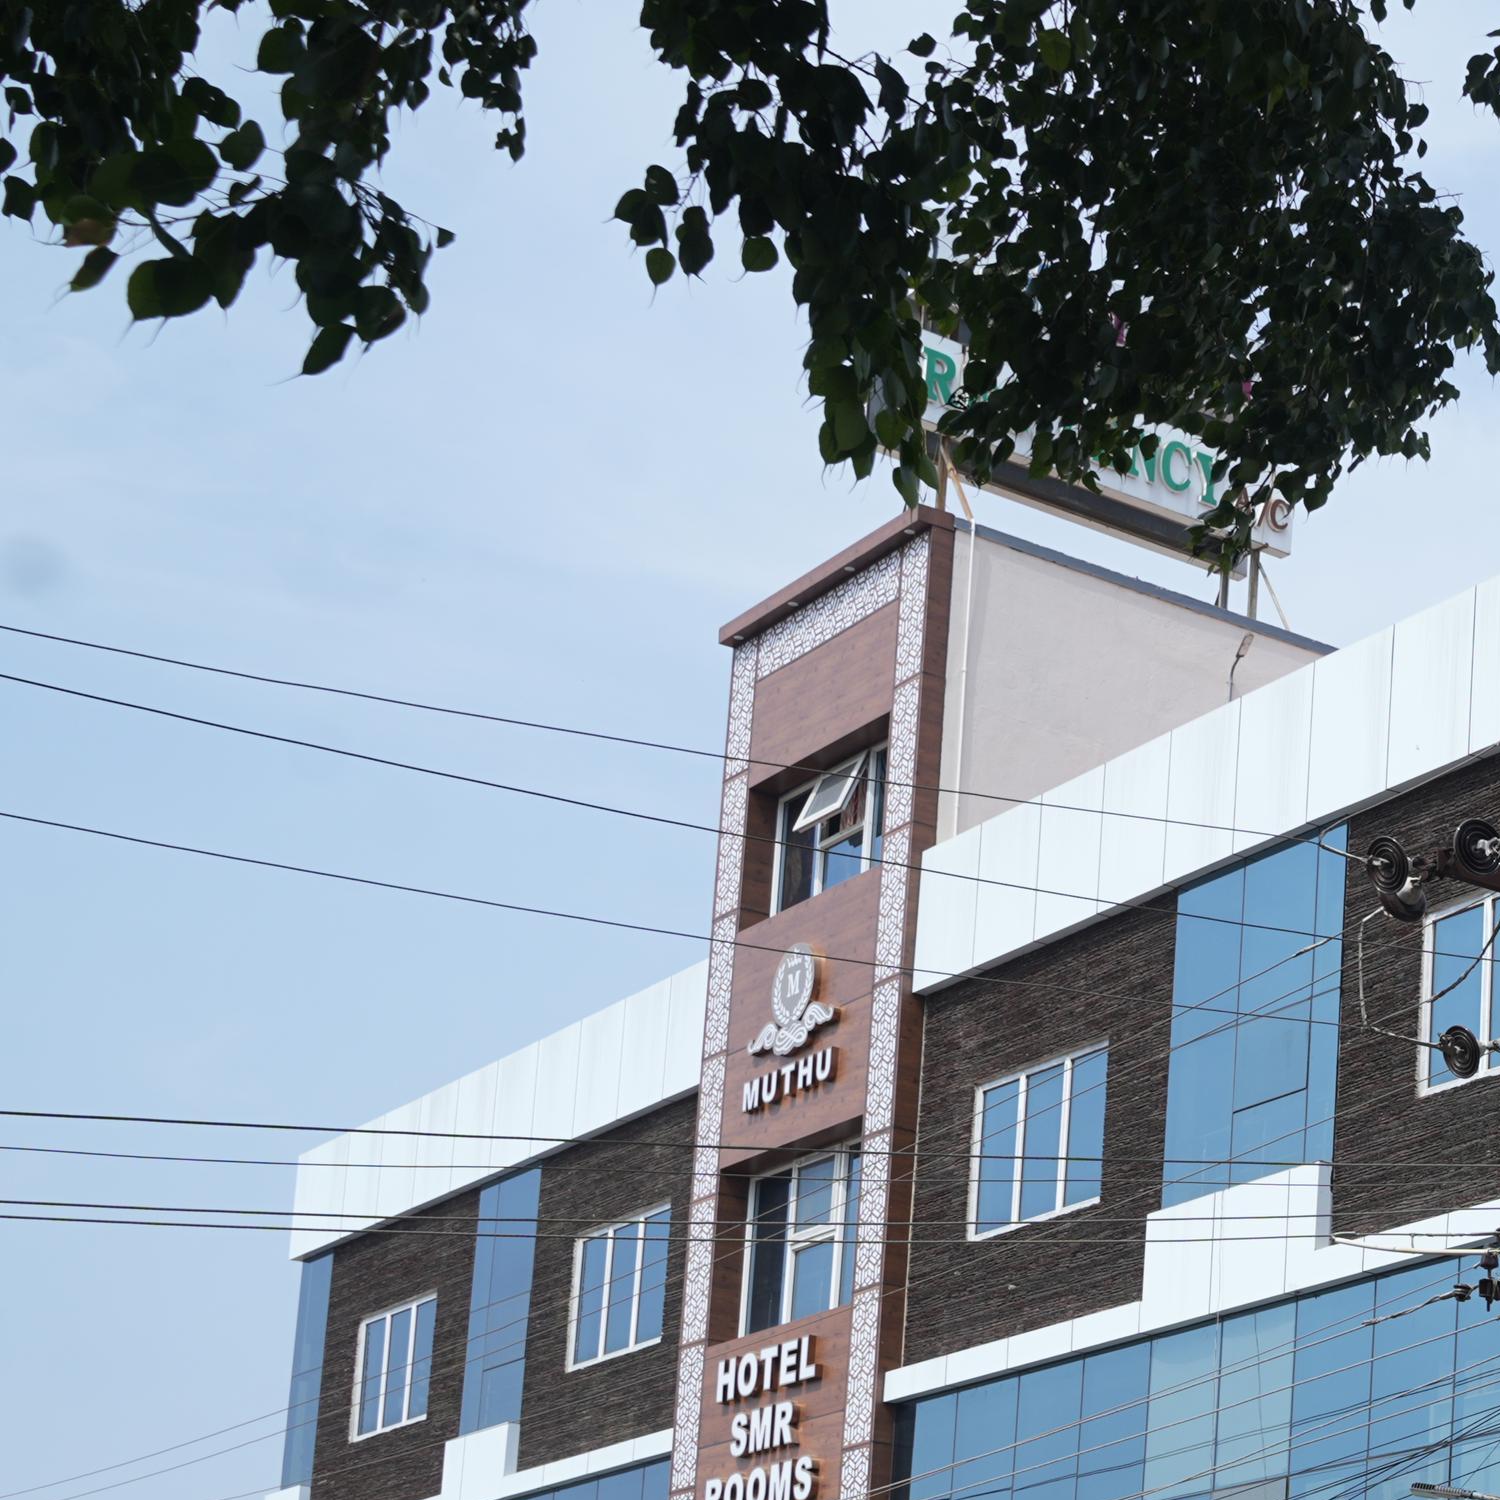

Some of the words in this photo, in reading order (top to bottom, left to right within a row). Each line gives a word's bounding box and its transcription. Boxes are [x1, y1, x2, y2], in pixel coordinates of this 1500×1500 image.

[742, 1047, 833, 1112] MUTHU
[716, 1335, 816, 1402] HOTEL
[730, 1402, 793, 1458] SMR
